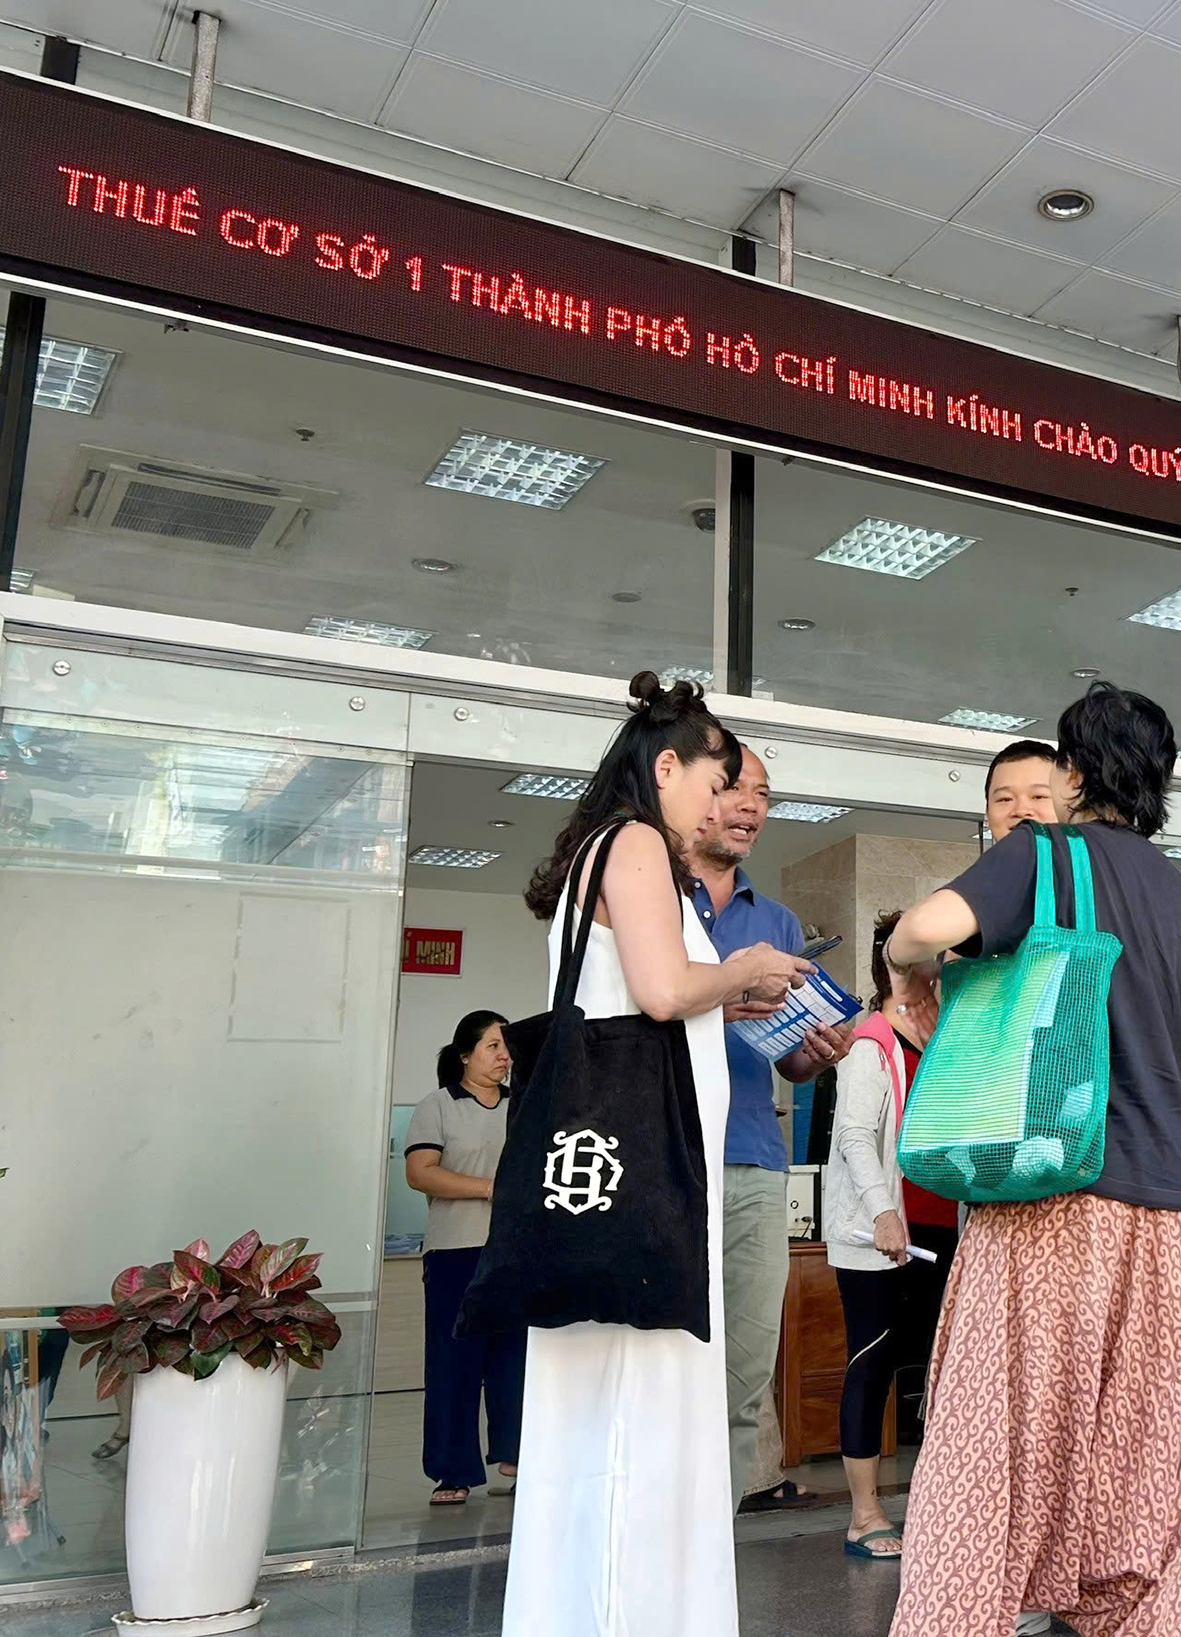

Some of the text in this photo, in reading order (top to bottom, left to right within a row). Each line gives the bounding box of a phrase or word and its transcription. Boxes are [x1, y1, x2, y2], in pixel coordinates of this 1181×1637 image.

[58, 165, 201, 236] THUẾ
[219, 207, 300, 258] CƠ
[315, 233, 390, 280] SỞ
[406, 256, 423, 292] 1
[441, 263, 590, 335] THÀNH
[607, 306, 692, 358] PHỐ
[706, 332, 760, 375] HỒ
[773, 355, 837, 395] CHÍ
[848, 369, 934, 420] MINH
[946, 394, 1022, 442] KÍNH
[1033, 421, 1118, 465] CHÀO
